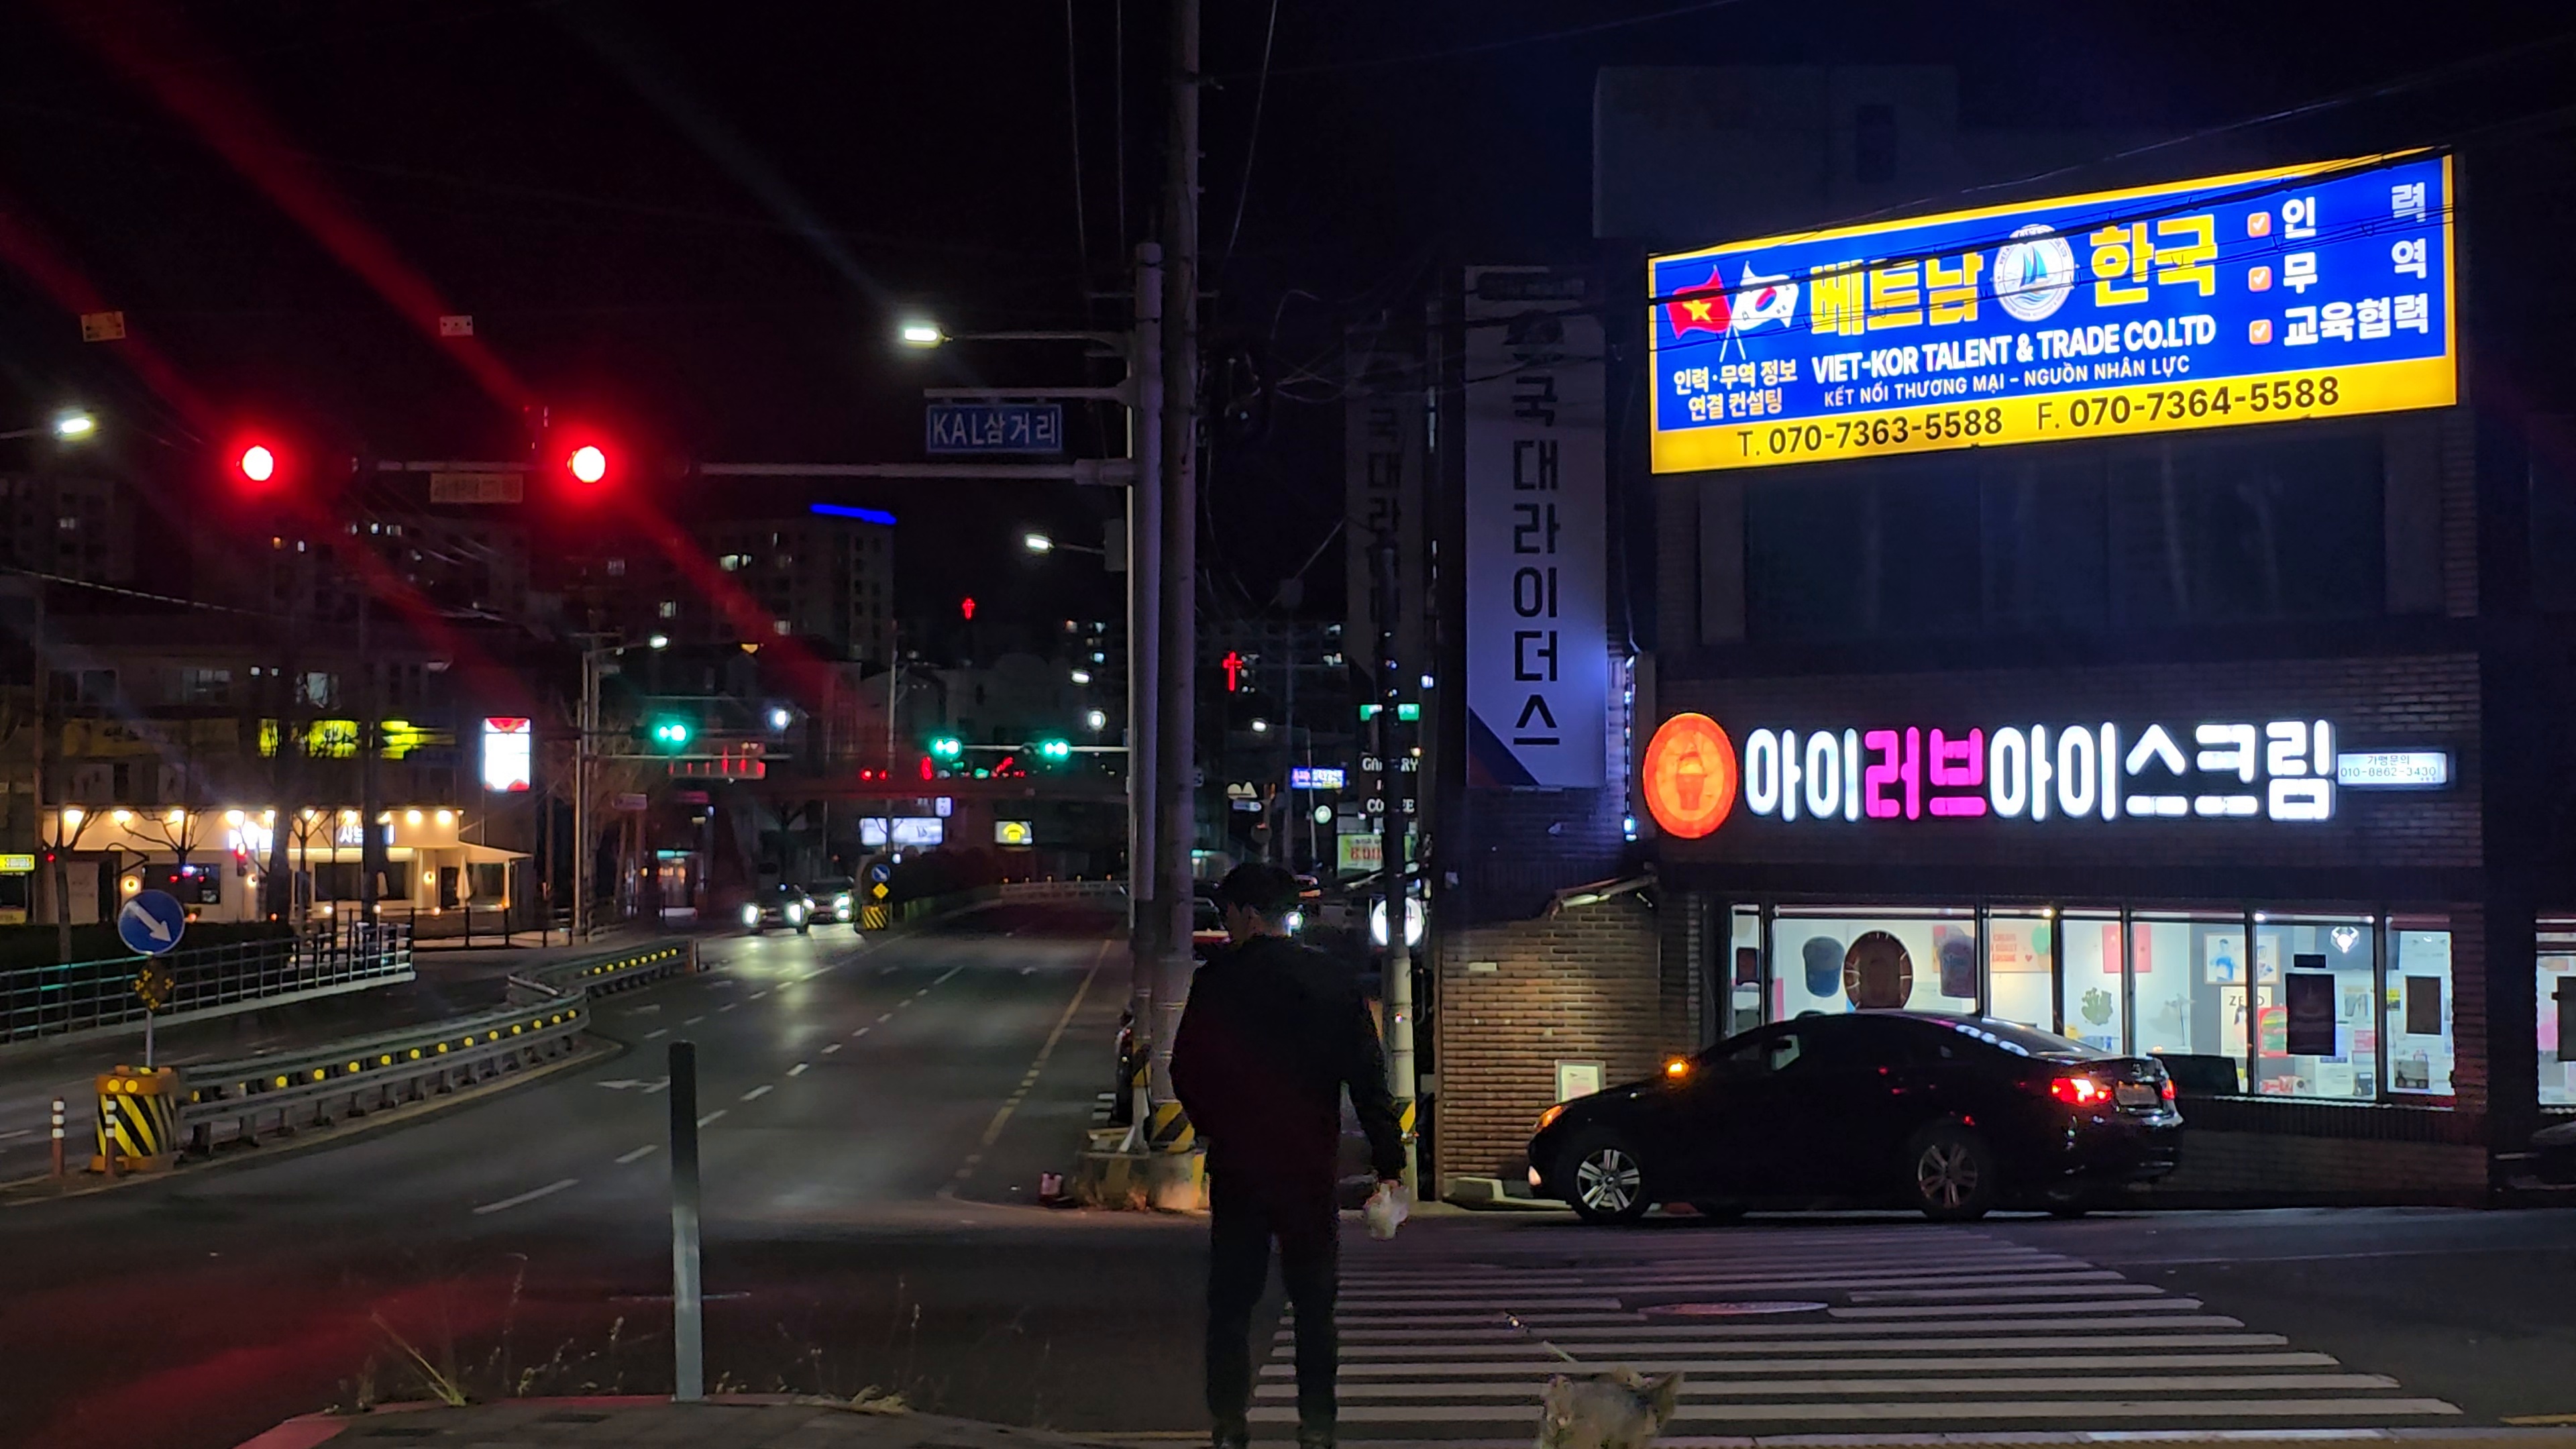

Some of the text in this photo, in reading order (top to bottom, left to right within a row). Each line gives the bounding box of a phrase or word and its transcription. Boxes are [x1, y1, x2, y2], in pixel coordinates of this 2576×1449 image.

[2282, 182, 2426, 239] 인 력
[1811, 251, 1984, 335] 베트남
[2090, 214, 2217, 307] 한국
[2284, 239, 2427, 293] 무 역
[2284, 293, 2428, 346] 교육협력
[1760, 359, 1799, 386] 정보
[1811, 314, 2216, 384] VIET-KOR TALENT & TRADE CO.LTD
[1688, 387, 1782, 421] 연결 컨설팅
[1825, 385, 1854, 407] KẾT
[1860, 380, 1888, 404] NỐI
[1894, 377, 1967, 400] THƯƠNG
[1973, 373, 2004, 394] MẠI
[2024, 362, 2088, 387] NGUỒN
[2094, 357, 2145, 380] NHÂN
[2152, 355, 2190, 378] LỰC
[933, 411, 1055, 445] KAL삼거리
[1737, 376, 2339, 457] T. 070-7363-5588 F. 070-7364-5588
[1746, 719, 2332, 822] 아이러브아이스크림
[2367, 755, 2410, 766] 가맹문의
[2229, 996, 2265, 1006] ZEO
